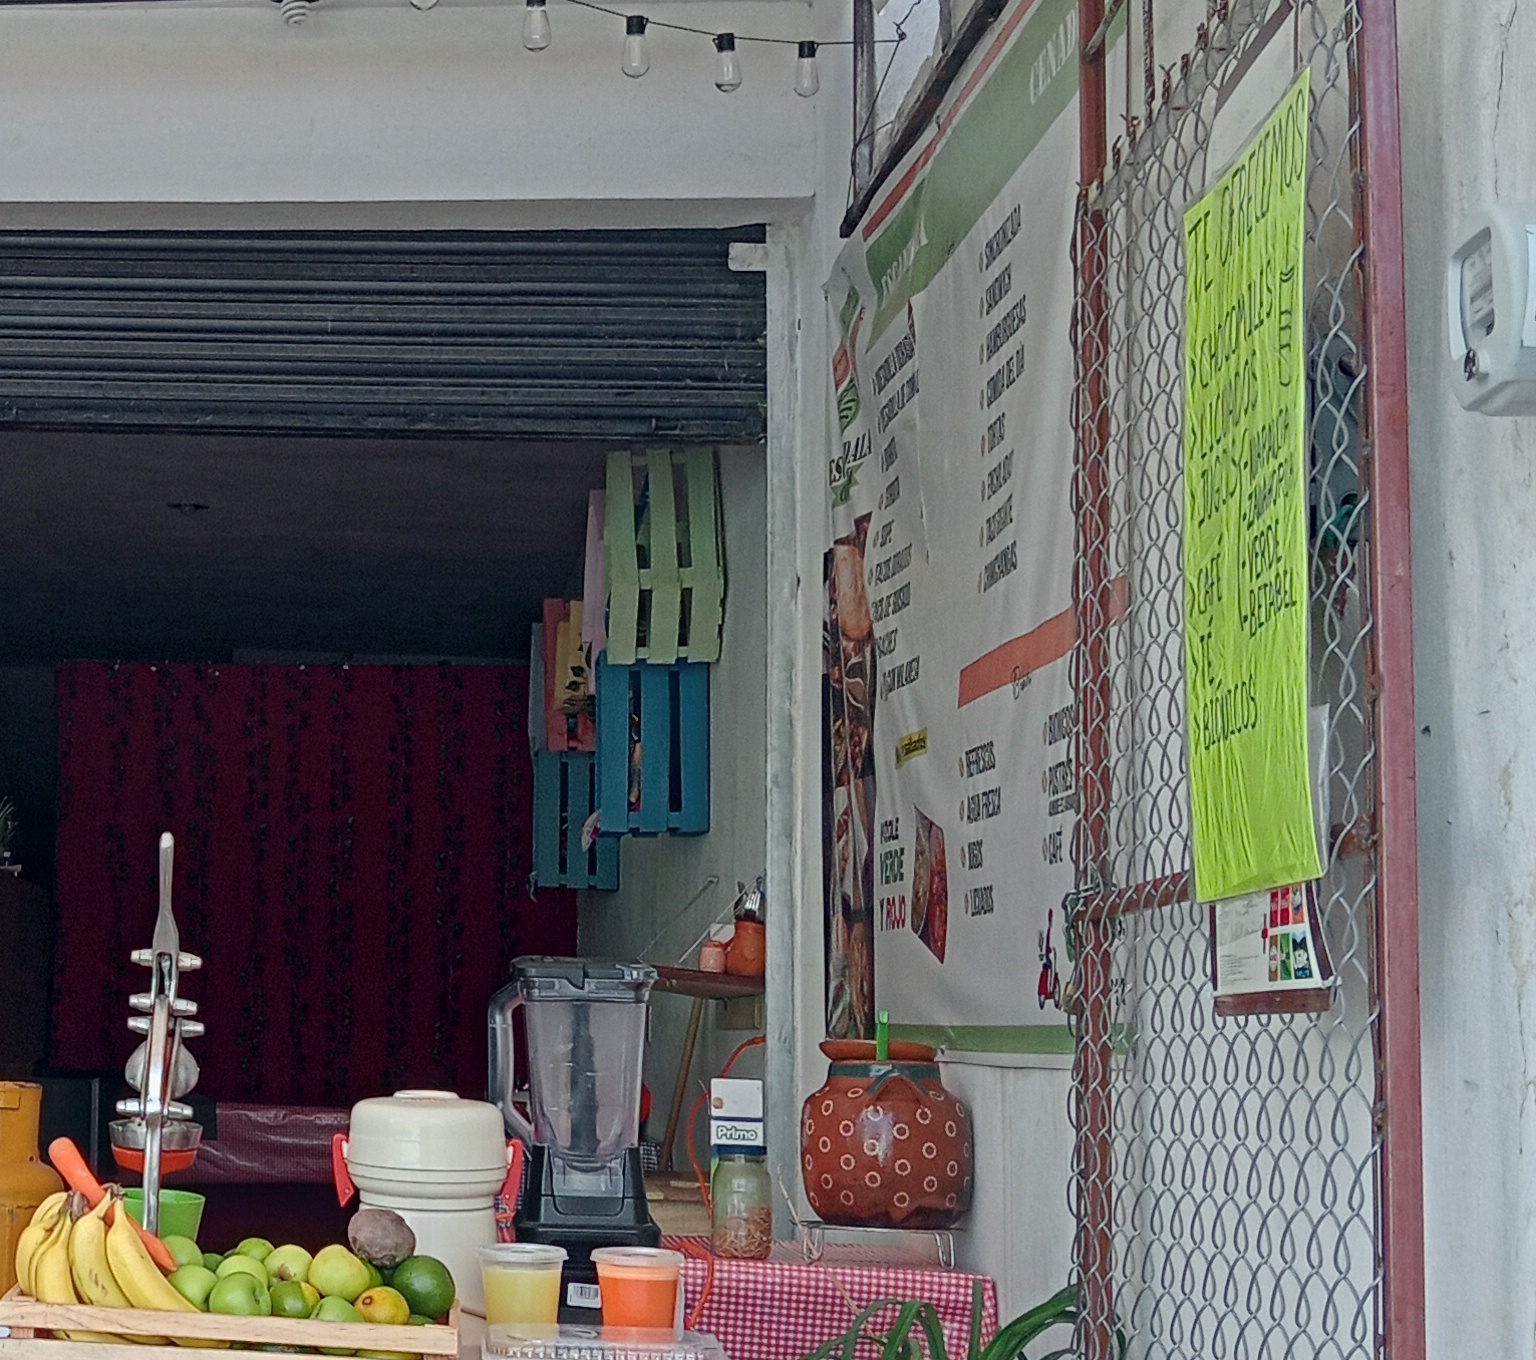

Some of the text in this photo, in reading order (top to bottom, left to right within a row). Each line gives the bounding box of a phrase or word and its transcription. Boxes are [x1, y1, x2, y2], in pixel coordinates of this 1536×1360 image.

[1187, 87, 1305, 303] TE OFRECEMOS
[1196, 517, 1283, 615] CAFÉ VERDE
[1249, 567, 1298, 639] BETABEL
[1199, 614, 1215, 690] TÉ
[879, 847, 905, 886] VERDE
[885, 894, 906, 931] ROJO
[716, 1125, 758, 1141] Primo
